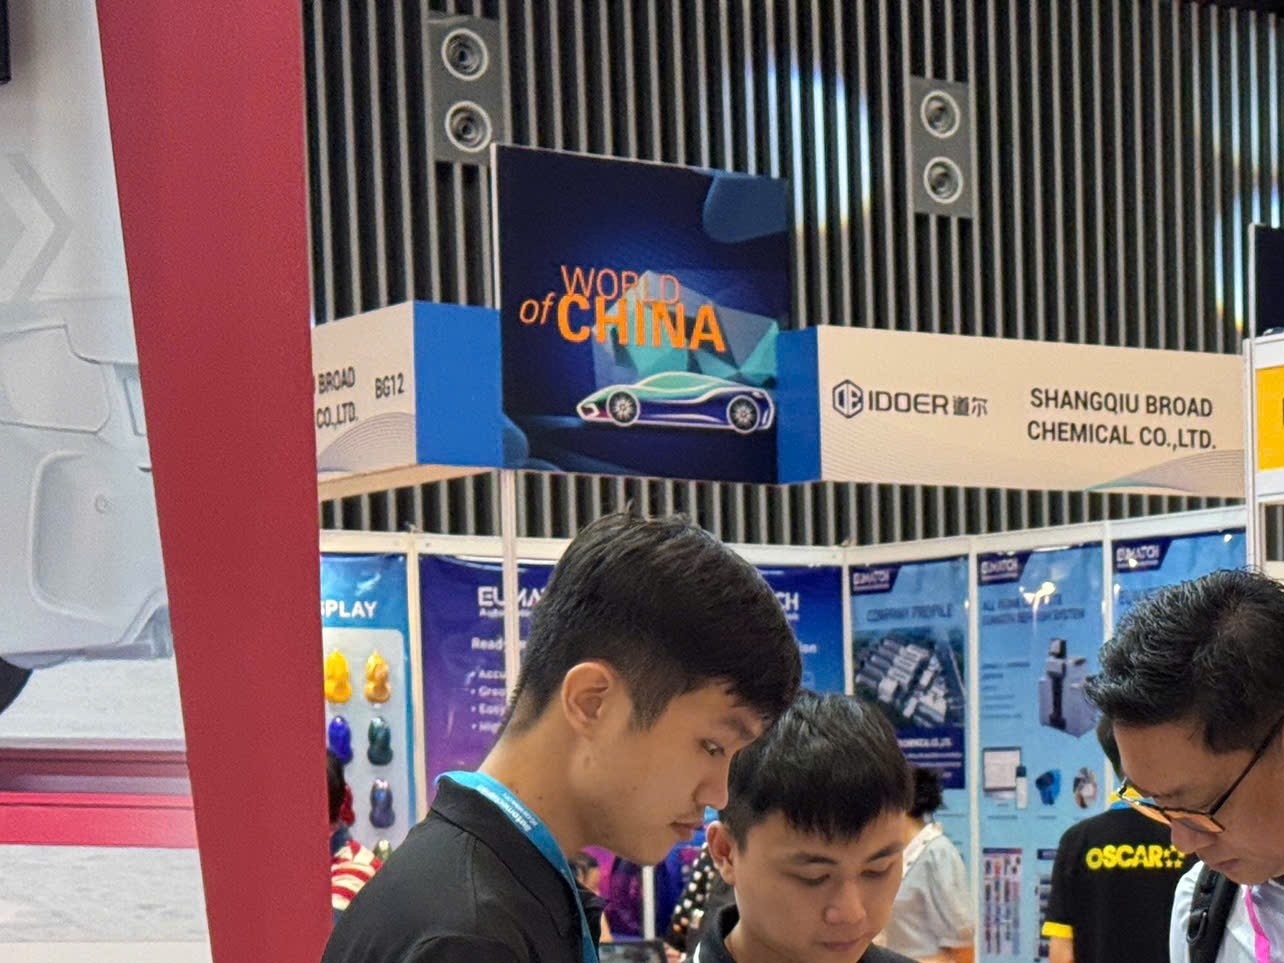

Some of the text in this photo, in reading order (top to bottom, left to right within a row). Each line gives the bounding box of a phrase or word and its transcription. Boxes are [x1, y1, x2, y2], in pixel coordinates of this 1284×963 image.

[561, 264, 681, 304] WORLD
[519, 293, 726, 353] of CHINA
[318, 366, 405, 399] BROAD BG12
[868, 390, 949, 416] IDOER
[1030, 388, 1213, 418] SHANGQIU BROAD
[1027, 421, 1217, 452] CHEMICAL CO.,LTD.
[1086, 844, 1163, 870] OSCAR
